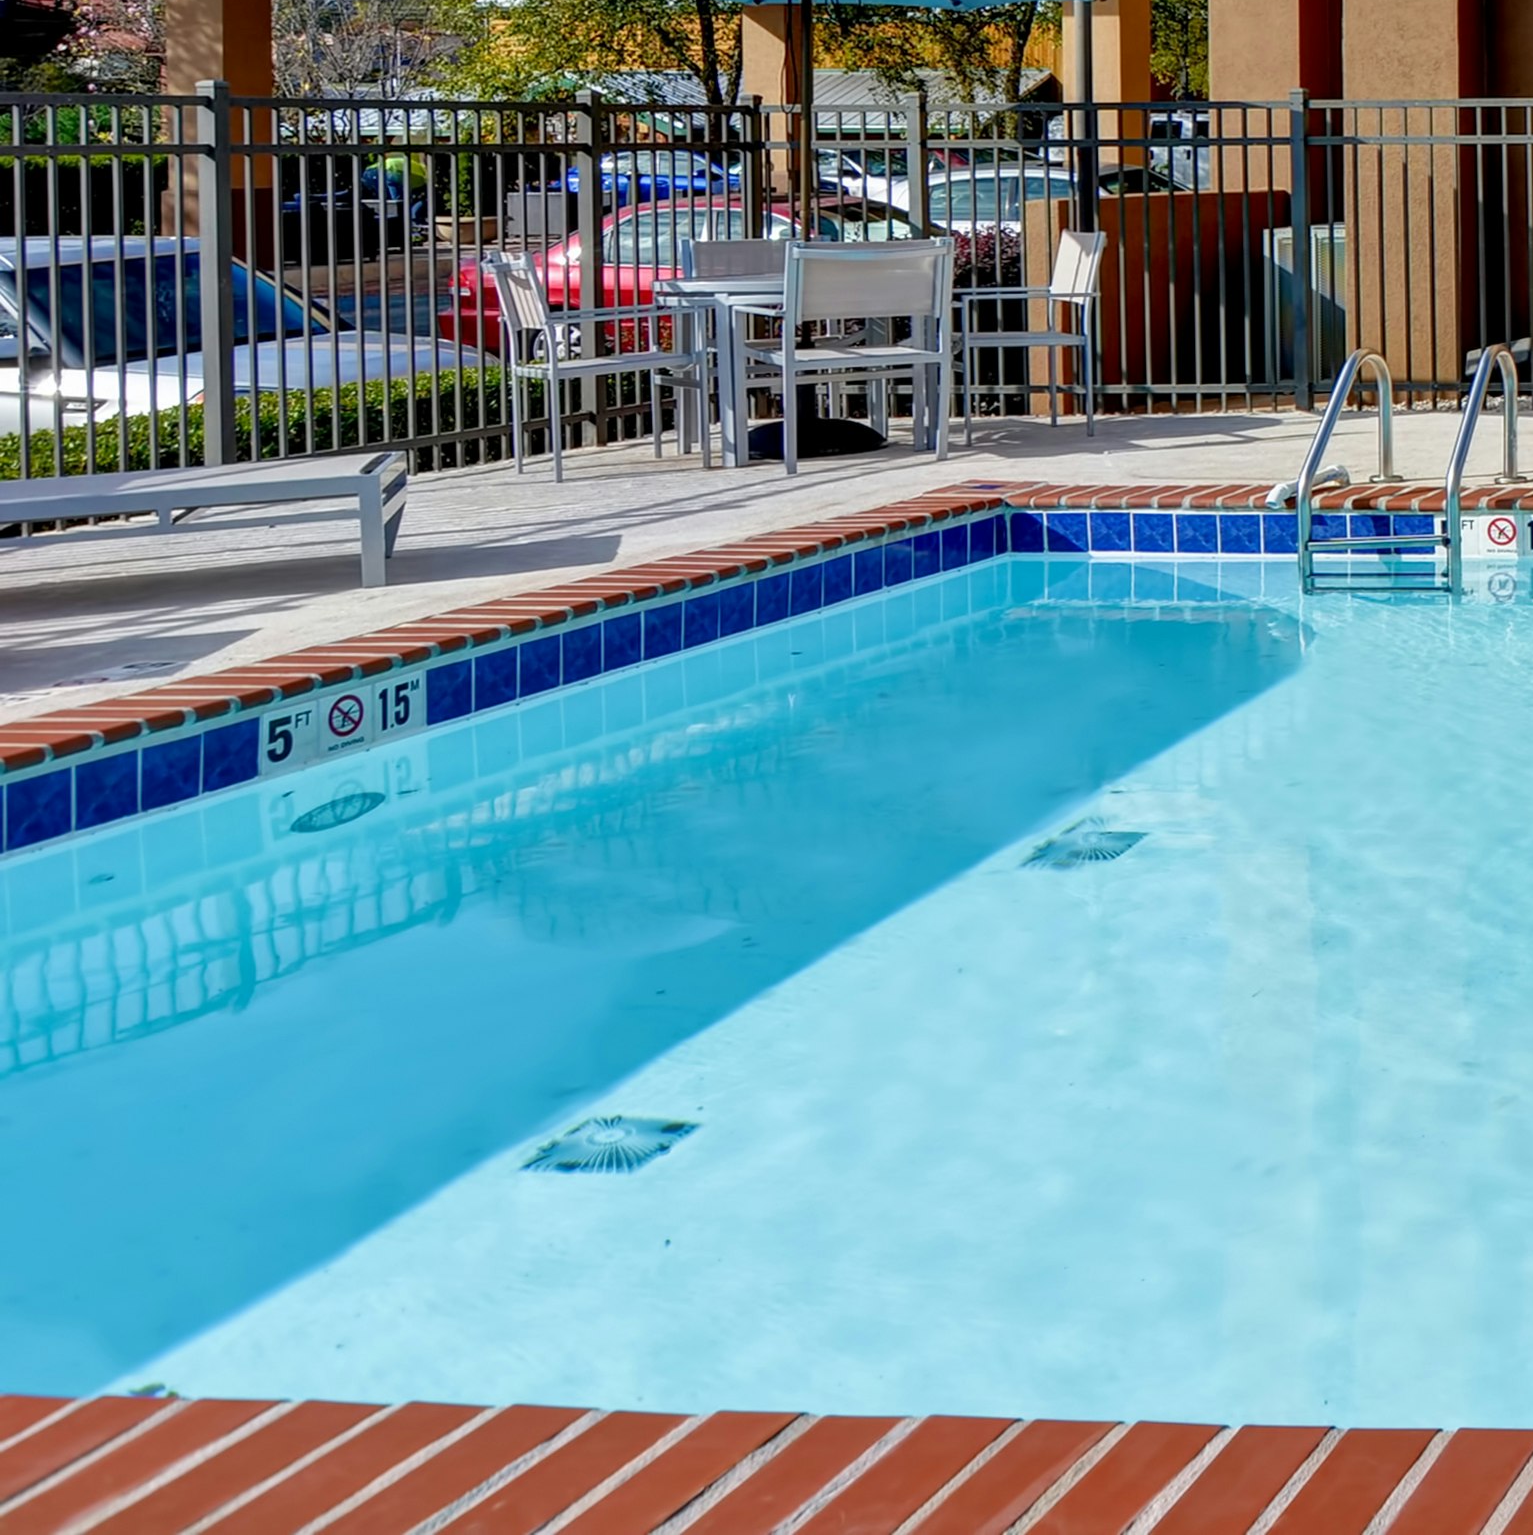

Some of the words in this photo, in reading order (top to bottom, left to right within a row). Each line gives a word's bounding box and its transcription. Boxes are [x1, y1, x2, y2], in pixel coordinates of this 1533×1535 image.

[1461, 519, 1475, 531] FT
[379, 682, 410, 731] 1.5
[410, 679, 420, 692] M
[267, 715, 293, 763] 5
[295, 710, 313, 729] FT
[341, 736, 365, 748] DIVING
